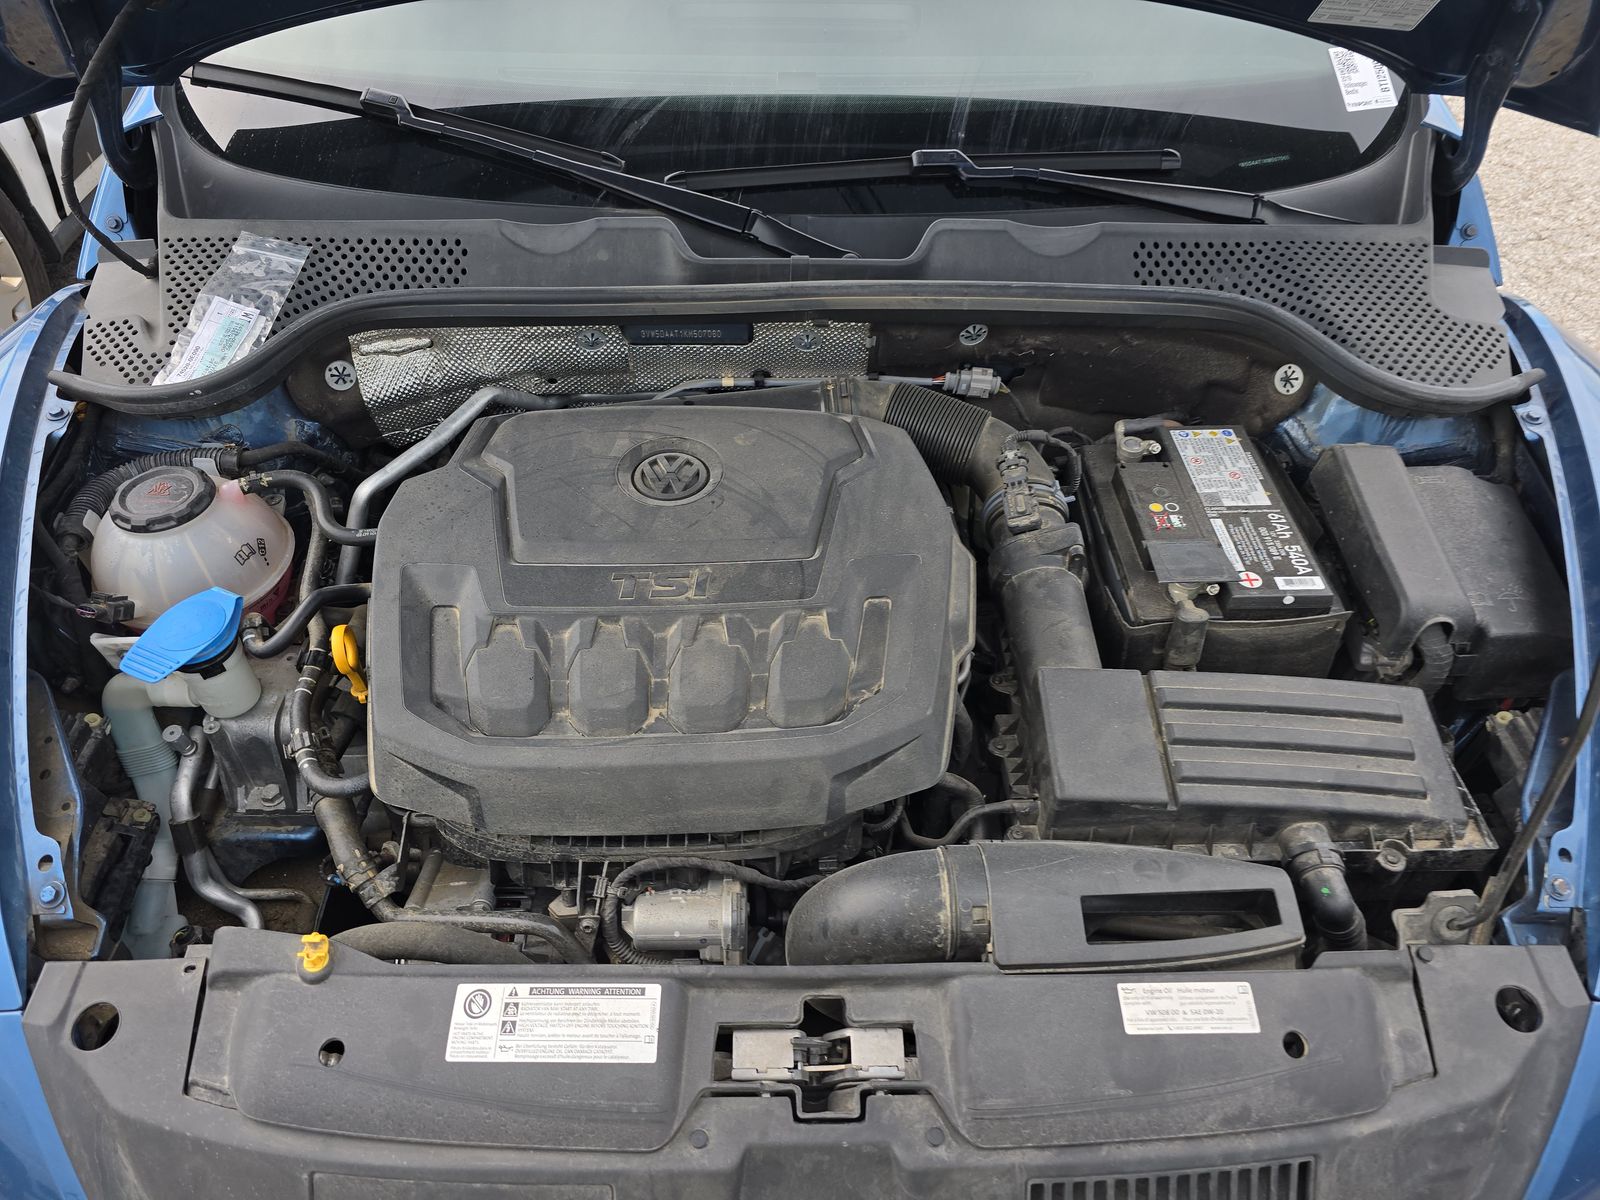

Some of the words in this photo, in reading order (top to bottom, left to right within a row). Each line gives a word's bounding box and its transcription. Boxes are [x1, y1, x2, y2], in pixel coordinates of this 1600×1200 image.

[1267, 513, 1294, 539] 61Ah
[1284, 544, 1313, 575] 540A
[612, 569, 713, 600] TSI
